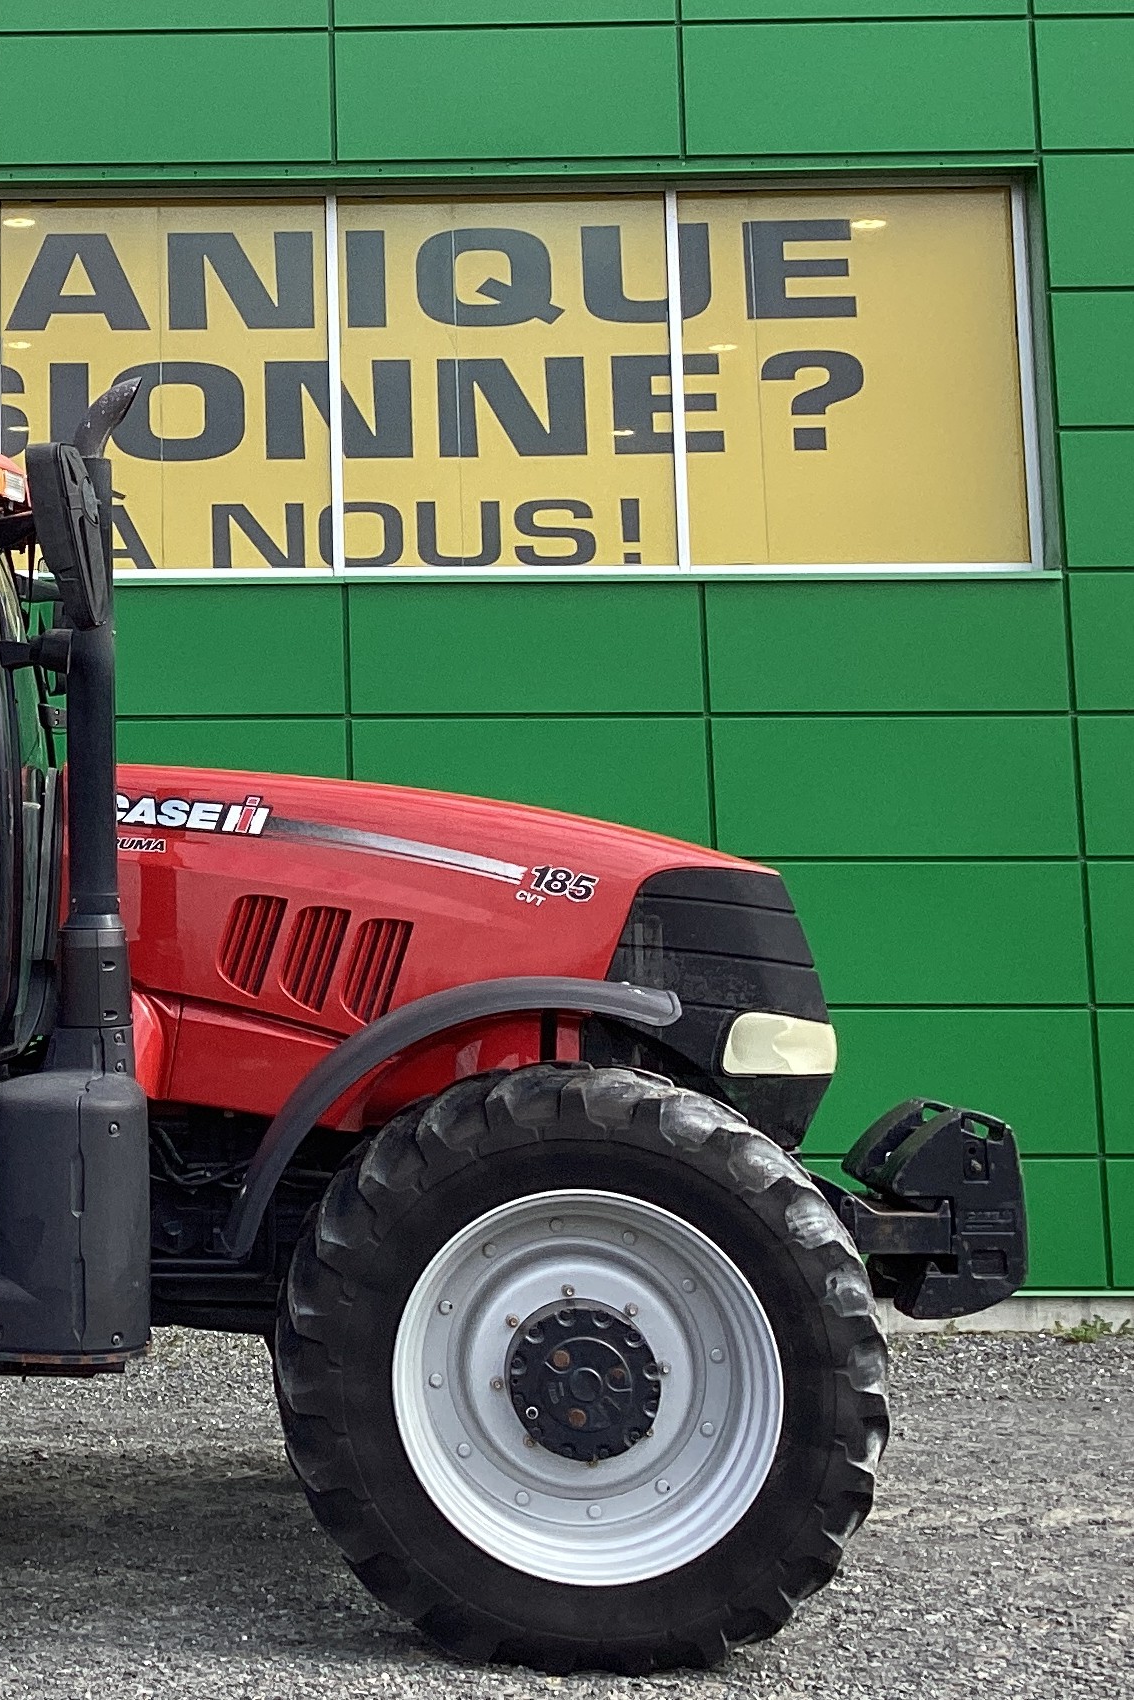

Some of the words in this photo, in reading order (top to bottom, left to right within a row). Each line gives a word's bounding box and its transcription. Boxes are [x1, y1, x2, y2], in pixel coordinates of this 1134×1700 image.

[212, 498, 641, 569] NOUS!
[116, 837, 166, 853] UMA
[531, 864, 600, 903] 185
[515, 889, 547, 907] CVT
